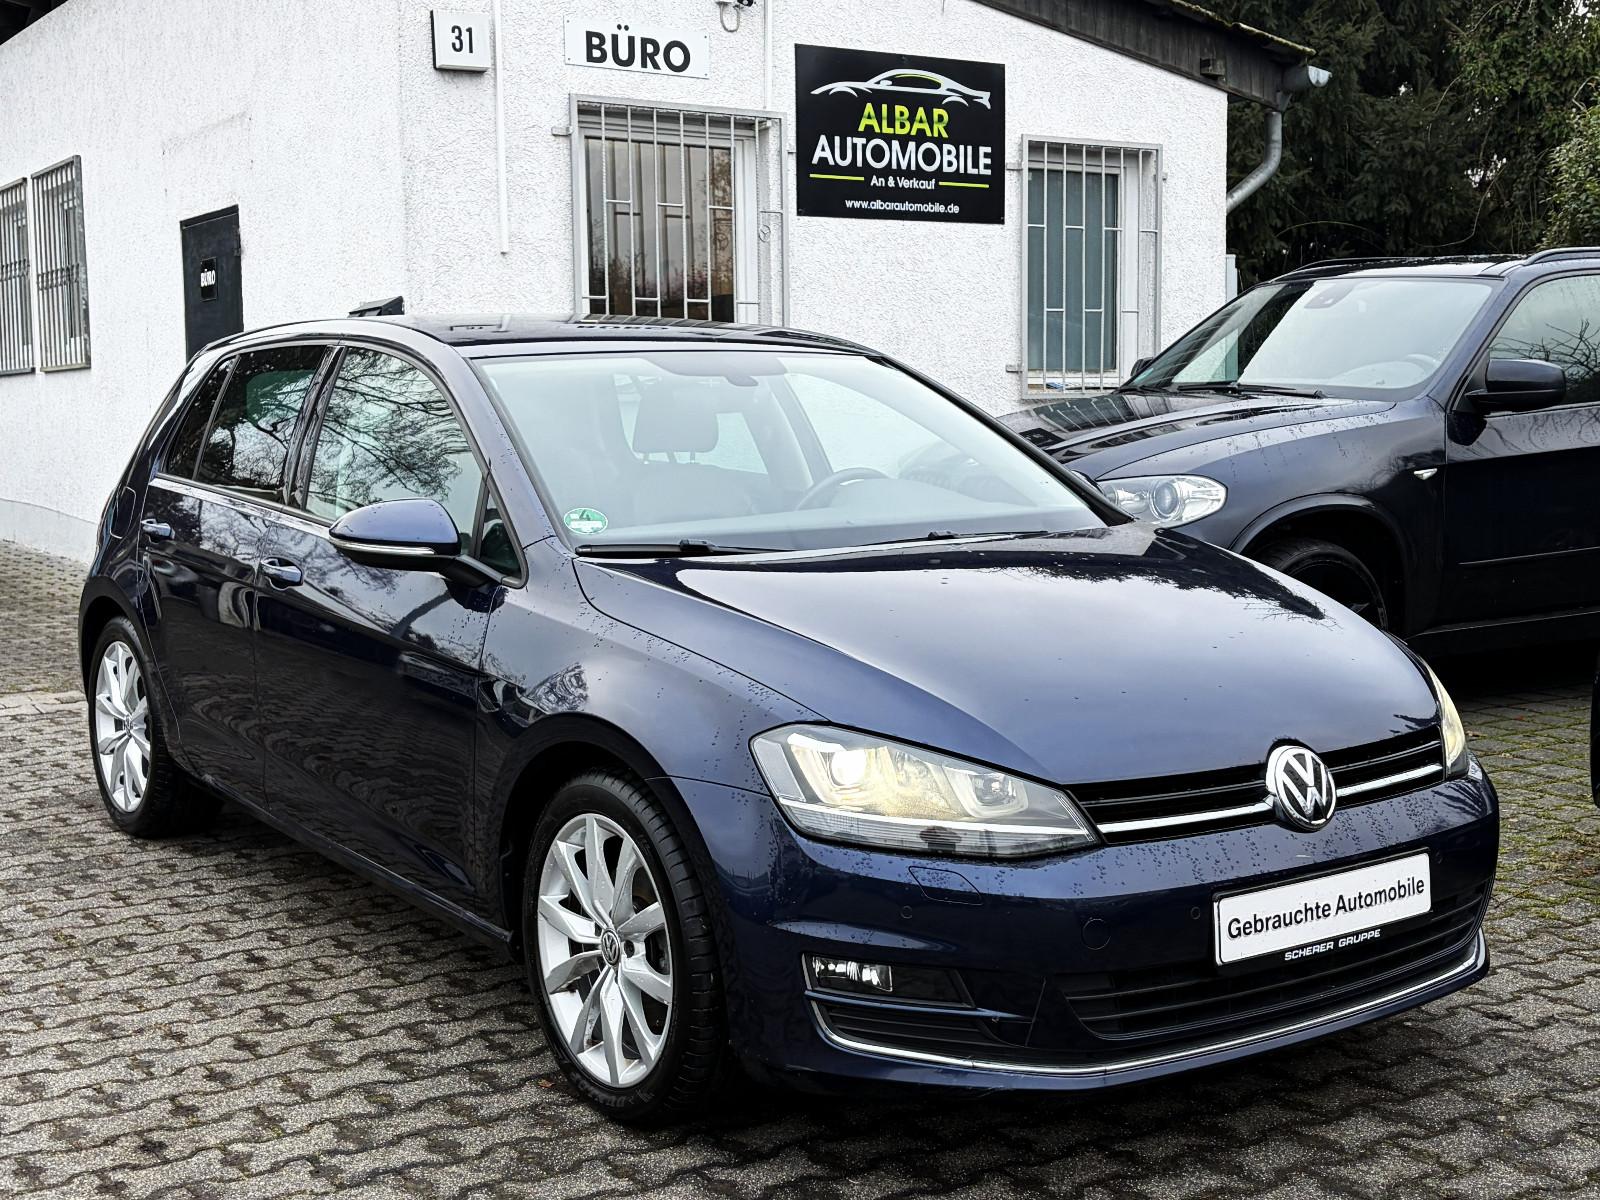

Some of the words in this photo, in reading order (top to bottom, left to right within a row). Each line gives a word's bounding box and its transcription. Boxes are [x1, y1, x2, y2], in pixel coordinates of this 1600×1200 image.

[451, 25, 473, 54] 31
[586, 24, 691, 72] BÜRO
[858, 103, 949, 138] ALBAR
[811, 135, 992, 175] AUTOMOBILE
[870, 175, 885, 187] An
[887, 177, 895, 187] &
[897, 177, 936, 190] Verkauf
[845, 199, 960, 213] www.albarautomobile.de
[1227, 902, 1331, 938] Gebrauchte
[1335, 876, 1425, 915] Automobile
[1284, 941, 1334, 961] SCHERER
[1338, 929, 1381, 947] GRUPPE
